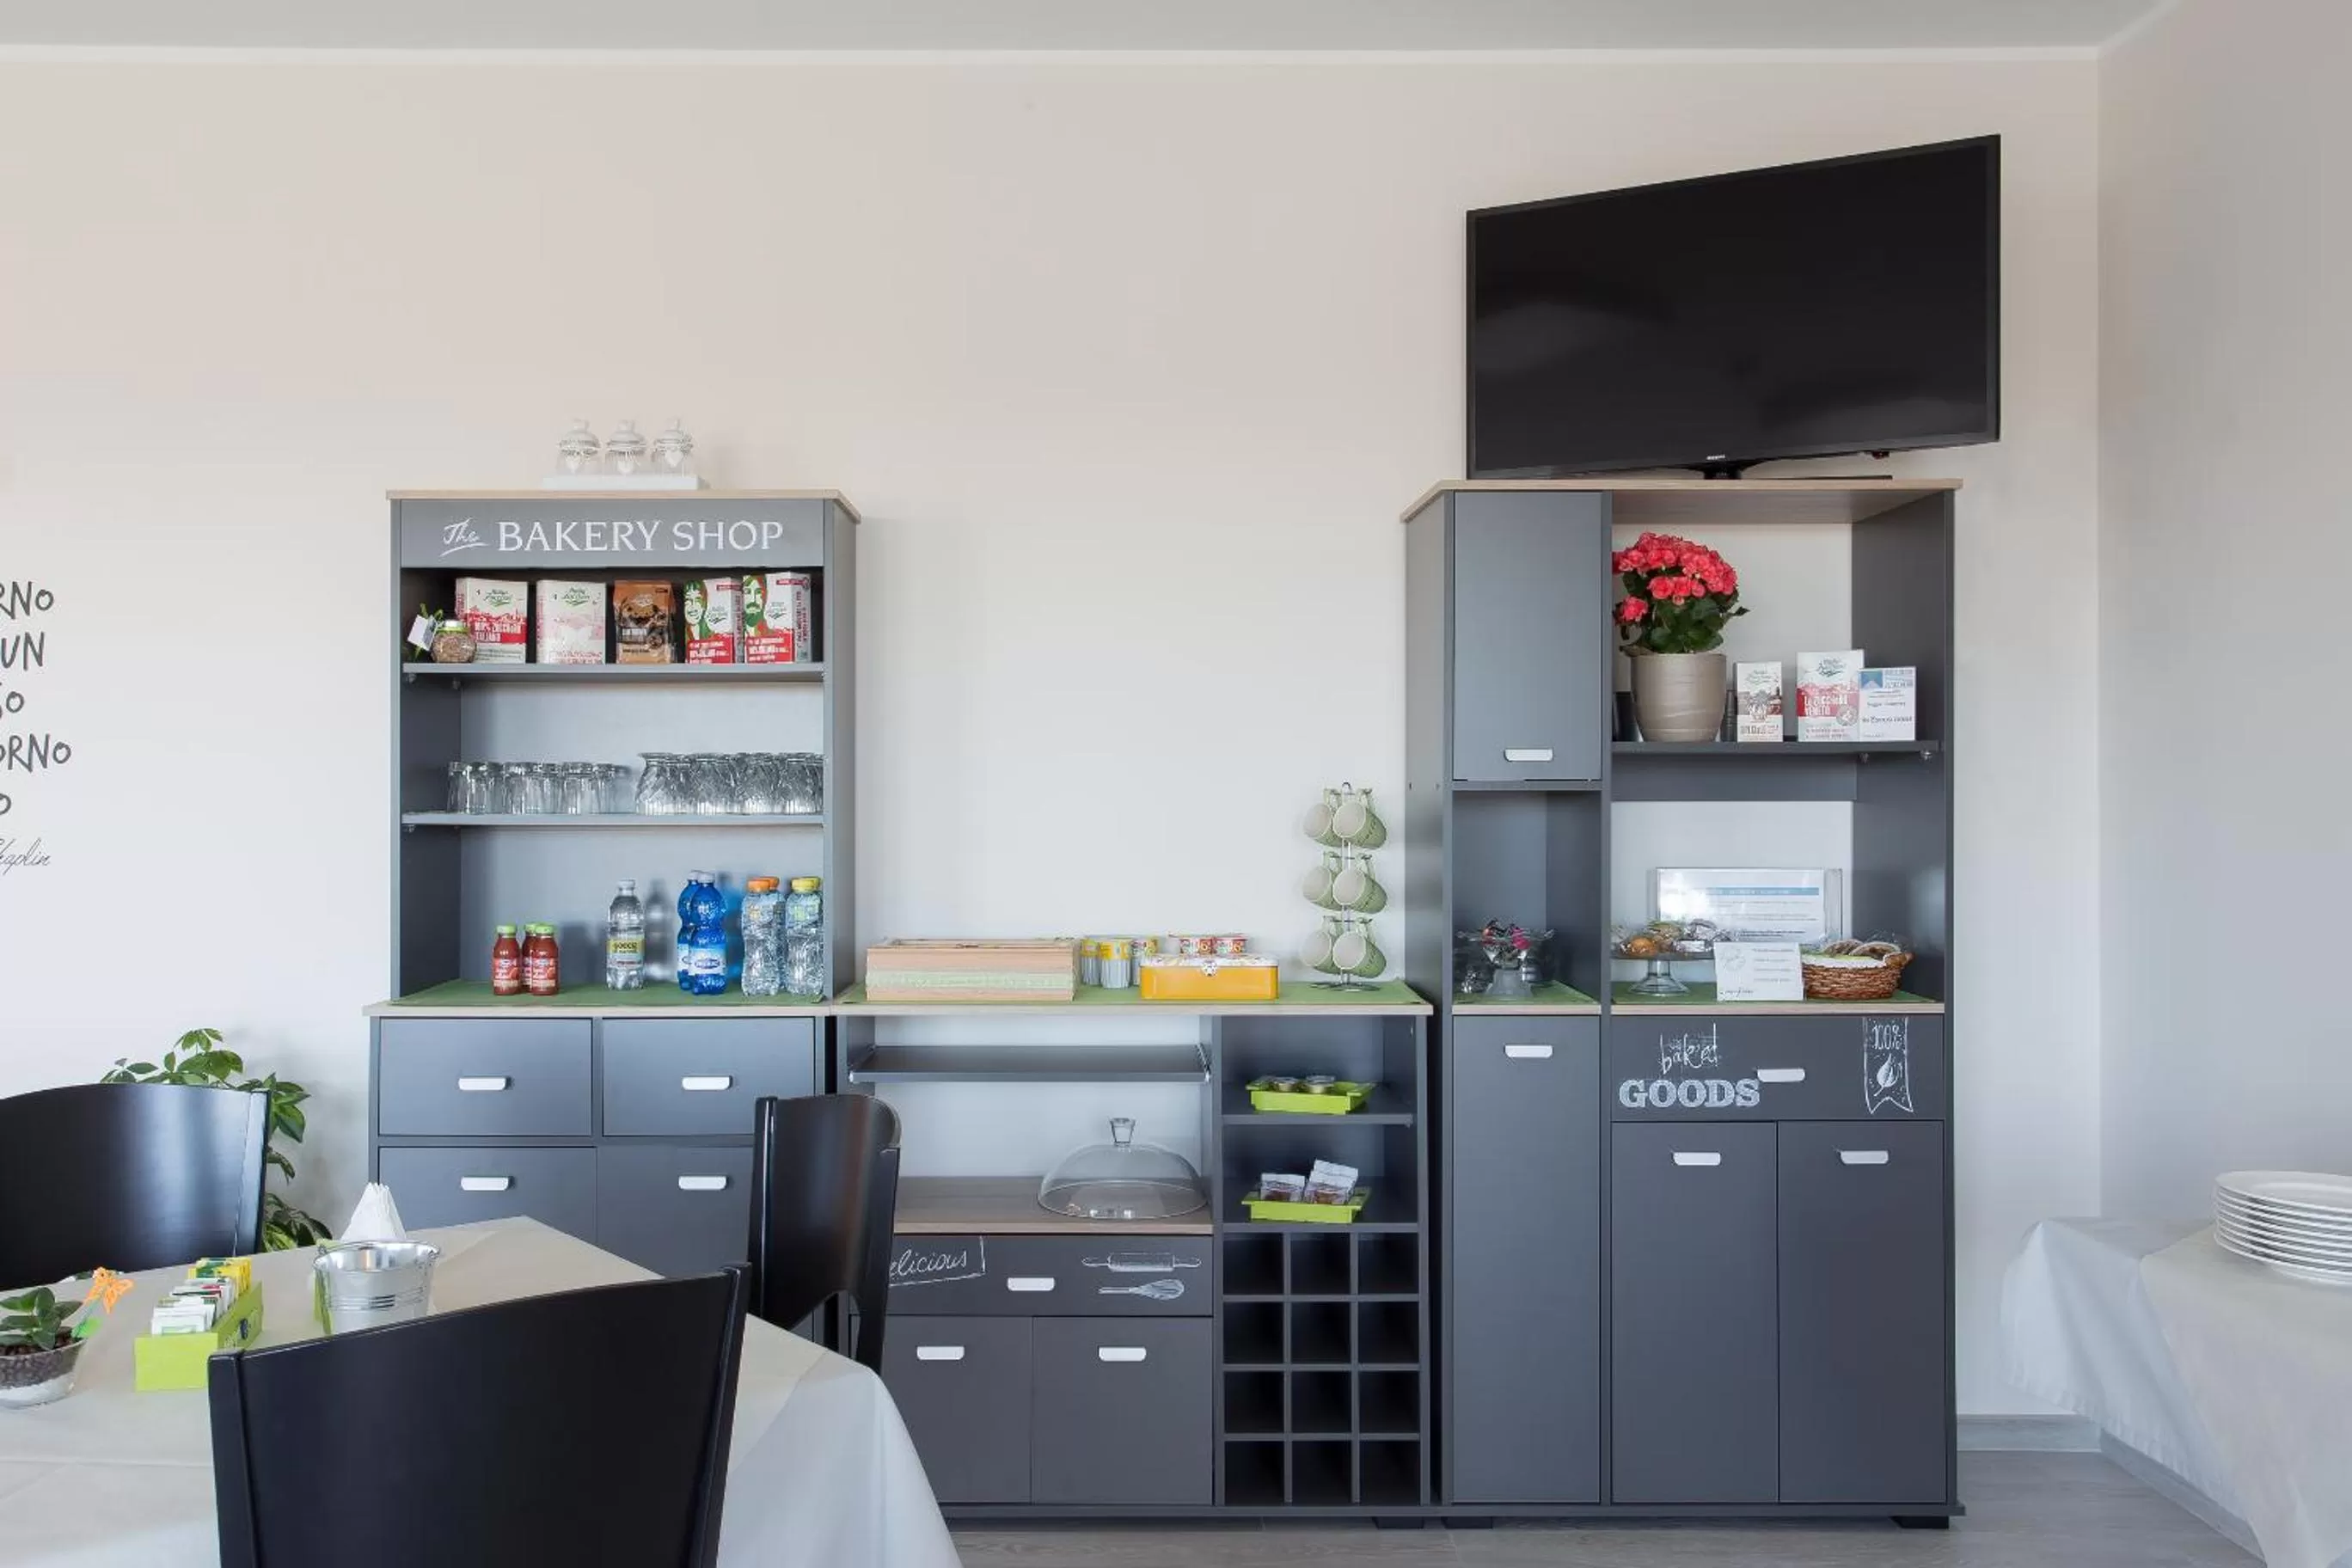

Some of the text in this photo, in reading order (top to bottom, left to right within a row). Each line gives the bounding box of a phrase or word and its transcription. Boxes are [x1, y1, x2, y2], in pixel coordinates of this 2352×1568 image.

[440, 518, 783, 552] The BAKERY SHOP
[1, 631, 46, 671] UN
[1658, 1023, 1718, 1075] baked
[1871, 1024, 1903, 1050] 100%
[1619, 1079, 1761, 1108] GOODS
[890, 1249, 967, 1279] elicious
